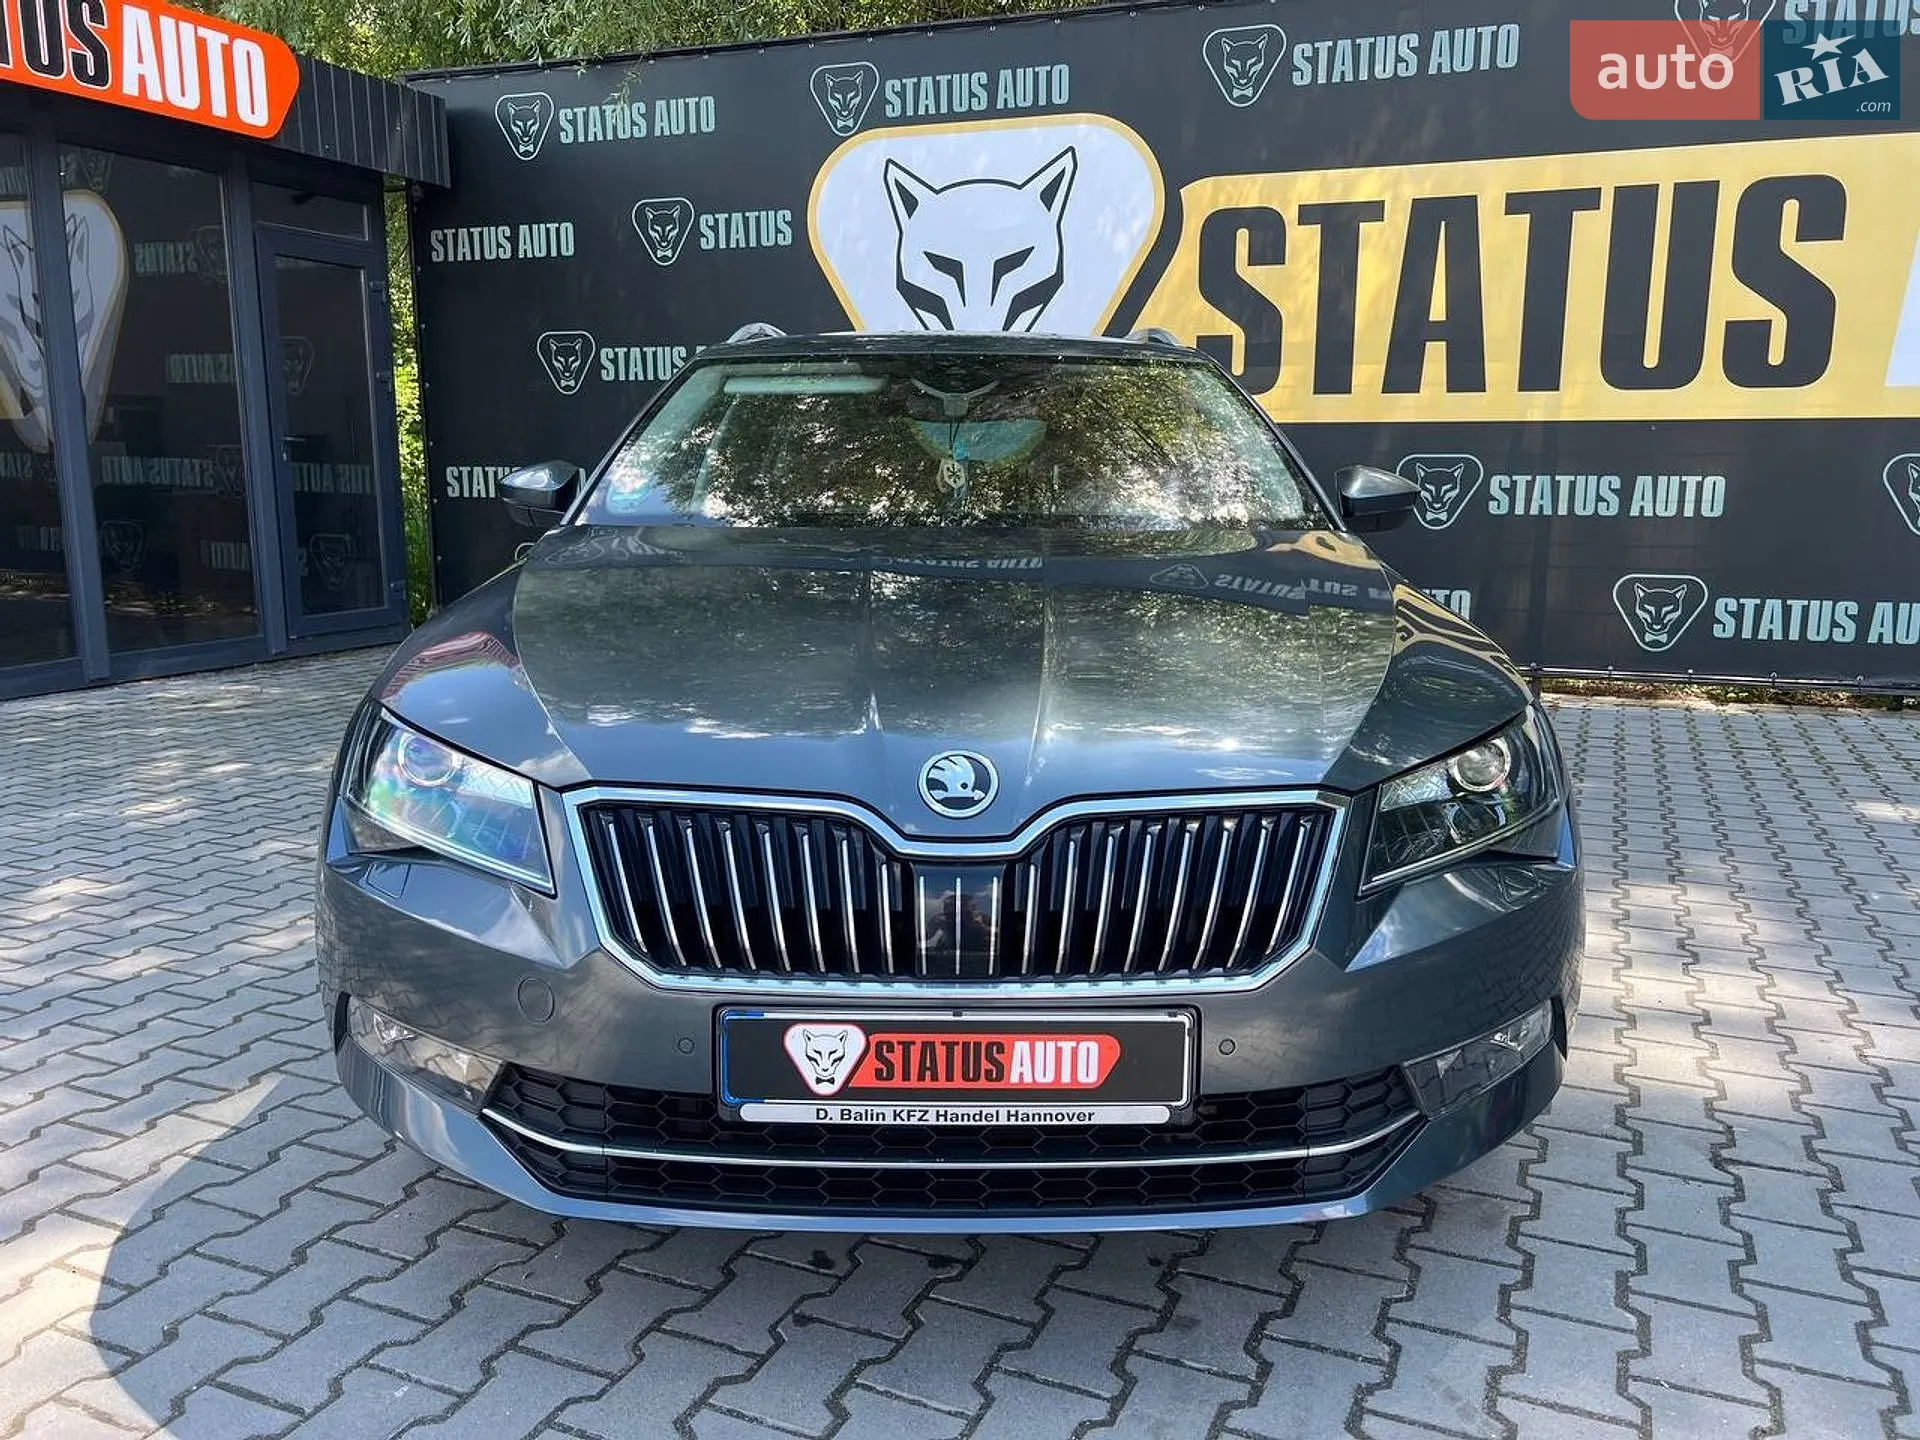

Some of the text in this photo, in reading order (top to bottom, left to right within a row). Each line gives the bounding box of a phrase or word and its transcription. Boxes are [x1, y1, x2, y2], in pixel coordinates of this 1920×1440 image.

[0, 0, 269, 127] US AUTO
[1292, 24, 1520, 86] STATUS AUTO
[884, 64, 1069, 117] STATUS AUTO
[559, 96, 715, 144] STATUS AUTO
[430, 222, 575, 262] STATUS AUTO
[700, 210, 792, 249] STATUS
[1196, 174, 1847, 394] STATUS
[600, 346, 687, 381] STATUS
[446, 466, 522, 498] STAT
[1489, 475, 1726, 518] STATUS AUTO
[1713, 598, 1859, 643] STATUS
[874, 1040, 1099, 1084] STATUS AUTO
[815, 1108, 1095, 1123] D. Balin KFZ Handel Hannover
